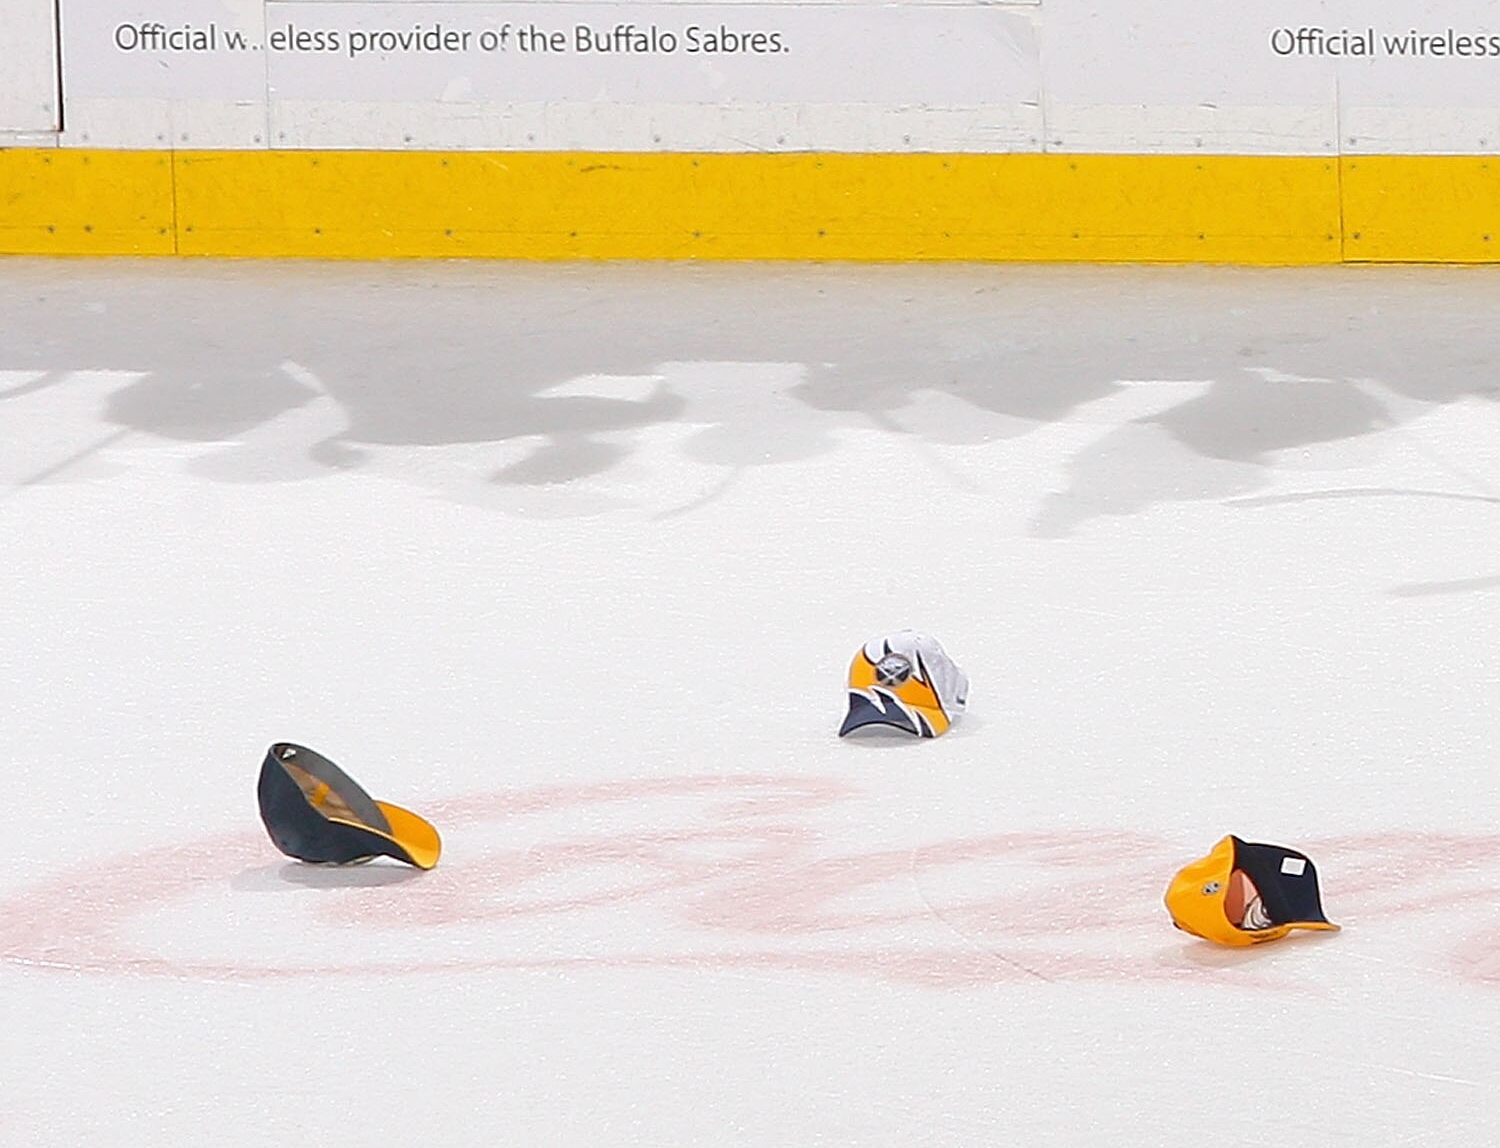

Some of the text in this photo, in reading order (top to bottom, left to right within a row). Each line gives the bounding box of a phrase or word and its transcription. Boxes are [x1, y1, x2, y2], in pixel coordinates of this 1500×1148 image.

[115, 23, 216, 51] Official
[350, 24, 472, 57] provider
[479, 24, 512, 52] of
[517, 25, 567, 53] the
[575, 25, 678, 53] Buffalo
[685, 26, 791, 54] Sabres.
[1271, 28, 1375, 56] Official
[1383, 28, 1500, 57] wireless
